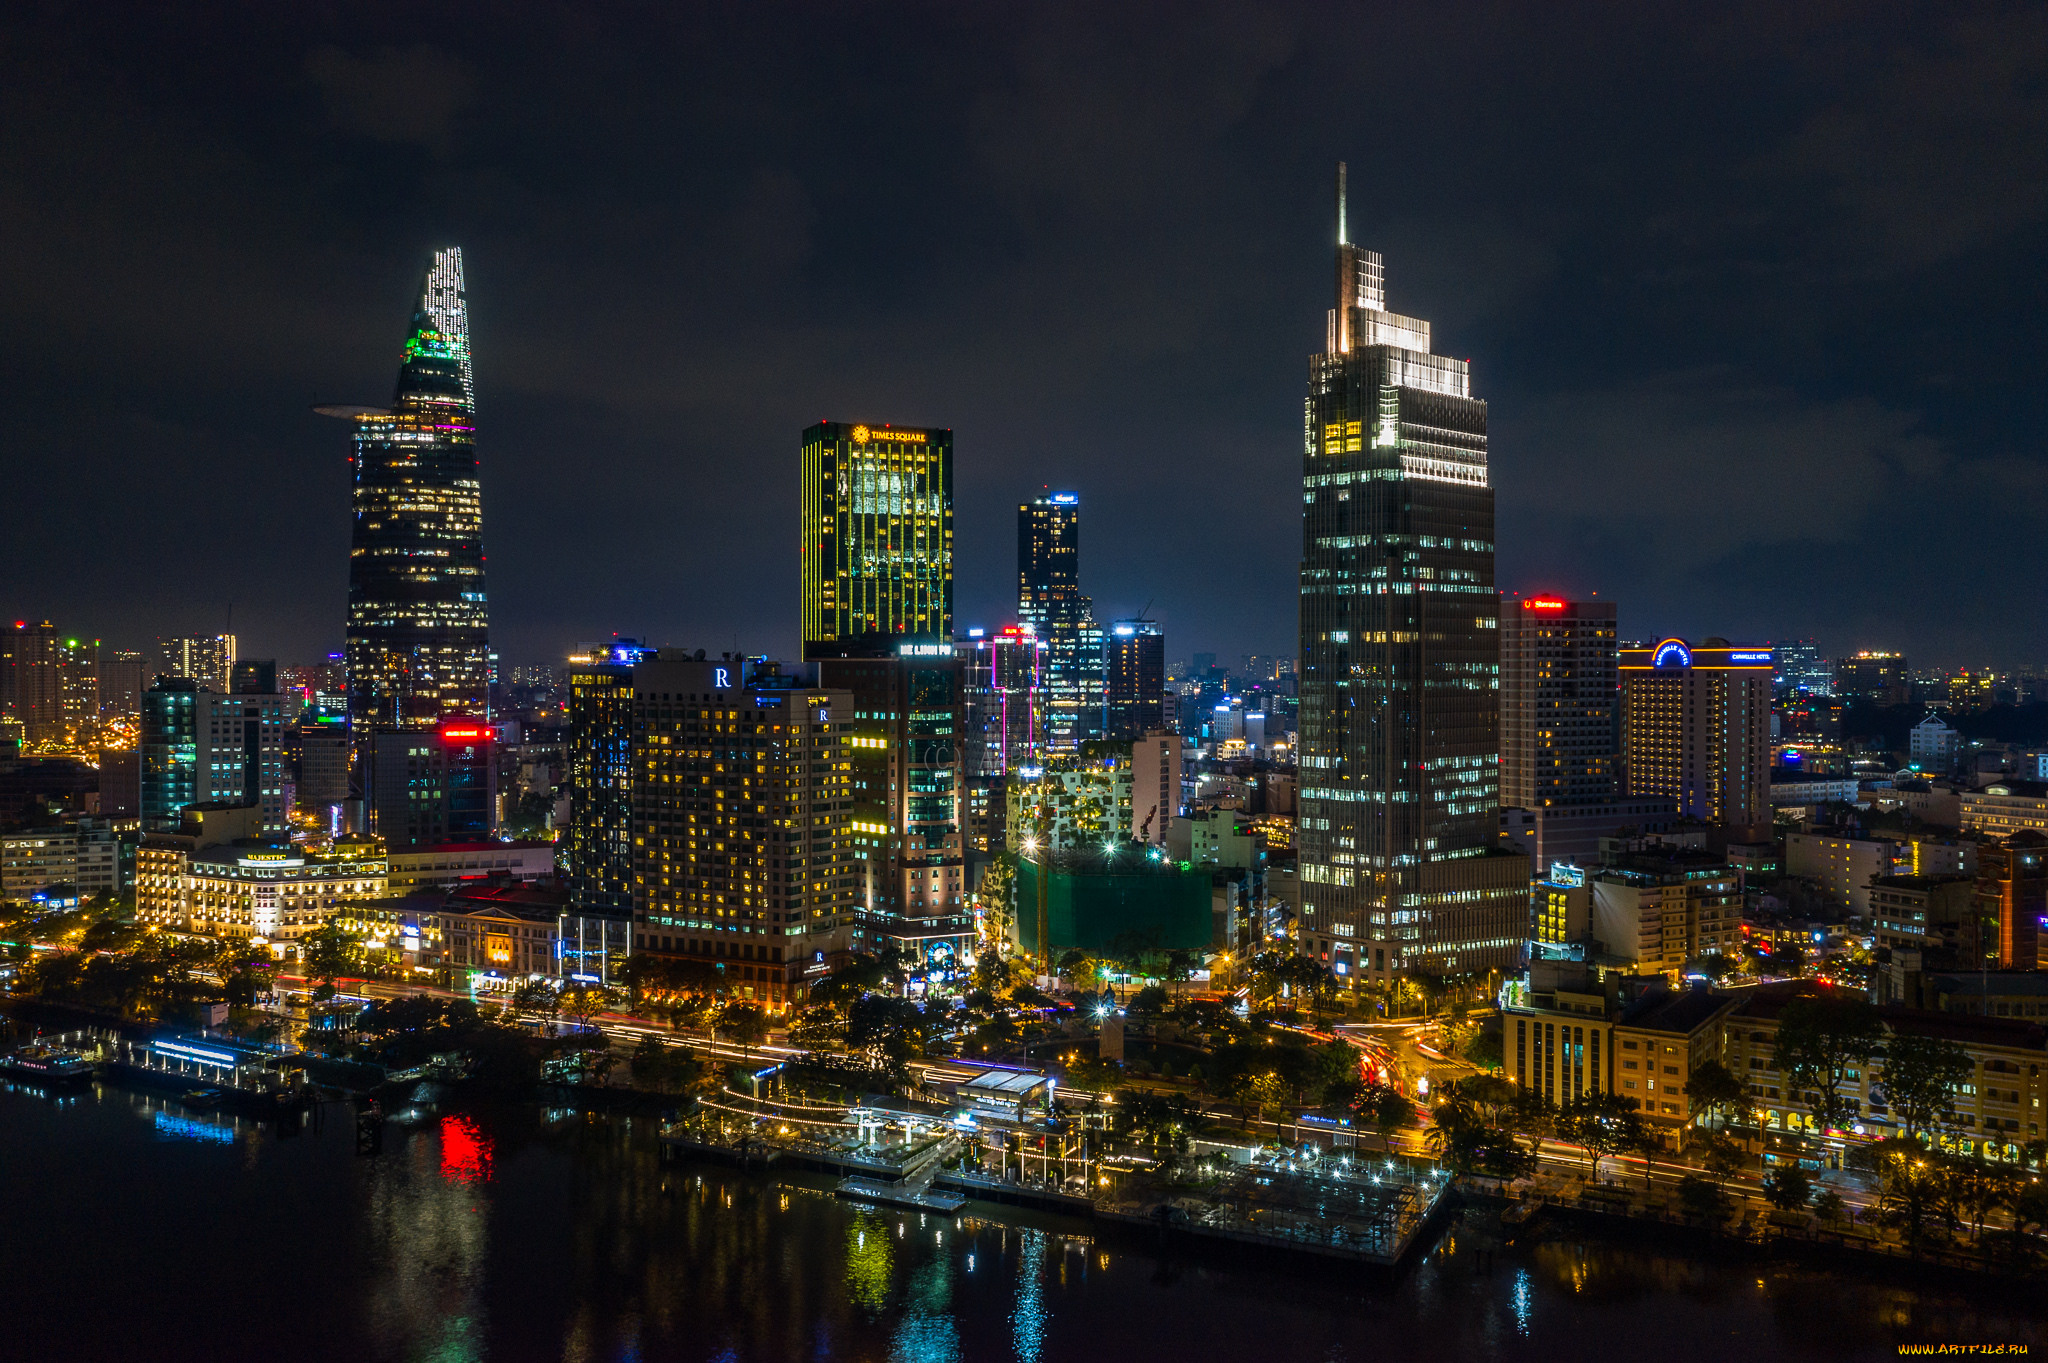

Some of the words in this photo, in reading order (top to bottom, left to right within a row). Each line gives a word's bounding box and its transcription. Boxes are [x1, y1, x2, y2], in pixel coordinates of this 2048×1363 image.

[872, 431, 894, 440] TIMES
[895, 432, 926, 442] SQUARE
[1656, 644, 1678, 666] CARAVELLE
[1678, 647, 1689, 666] HOTEL
[715, 668, 732, 688] R
[819, 709, 829, 721] R
[247, 853, 287, 861] MAJESTIC
[816, 952, 824, 962] R
